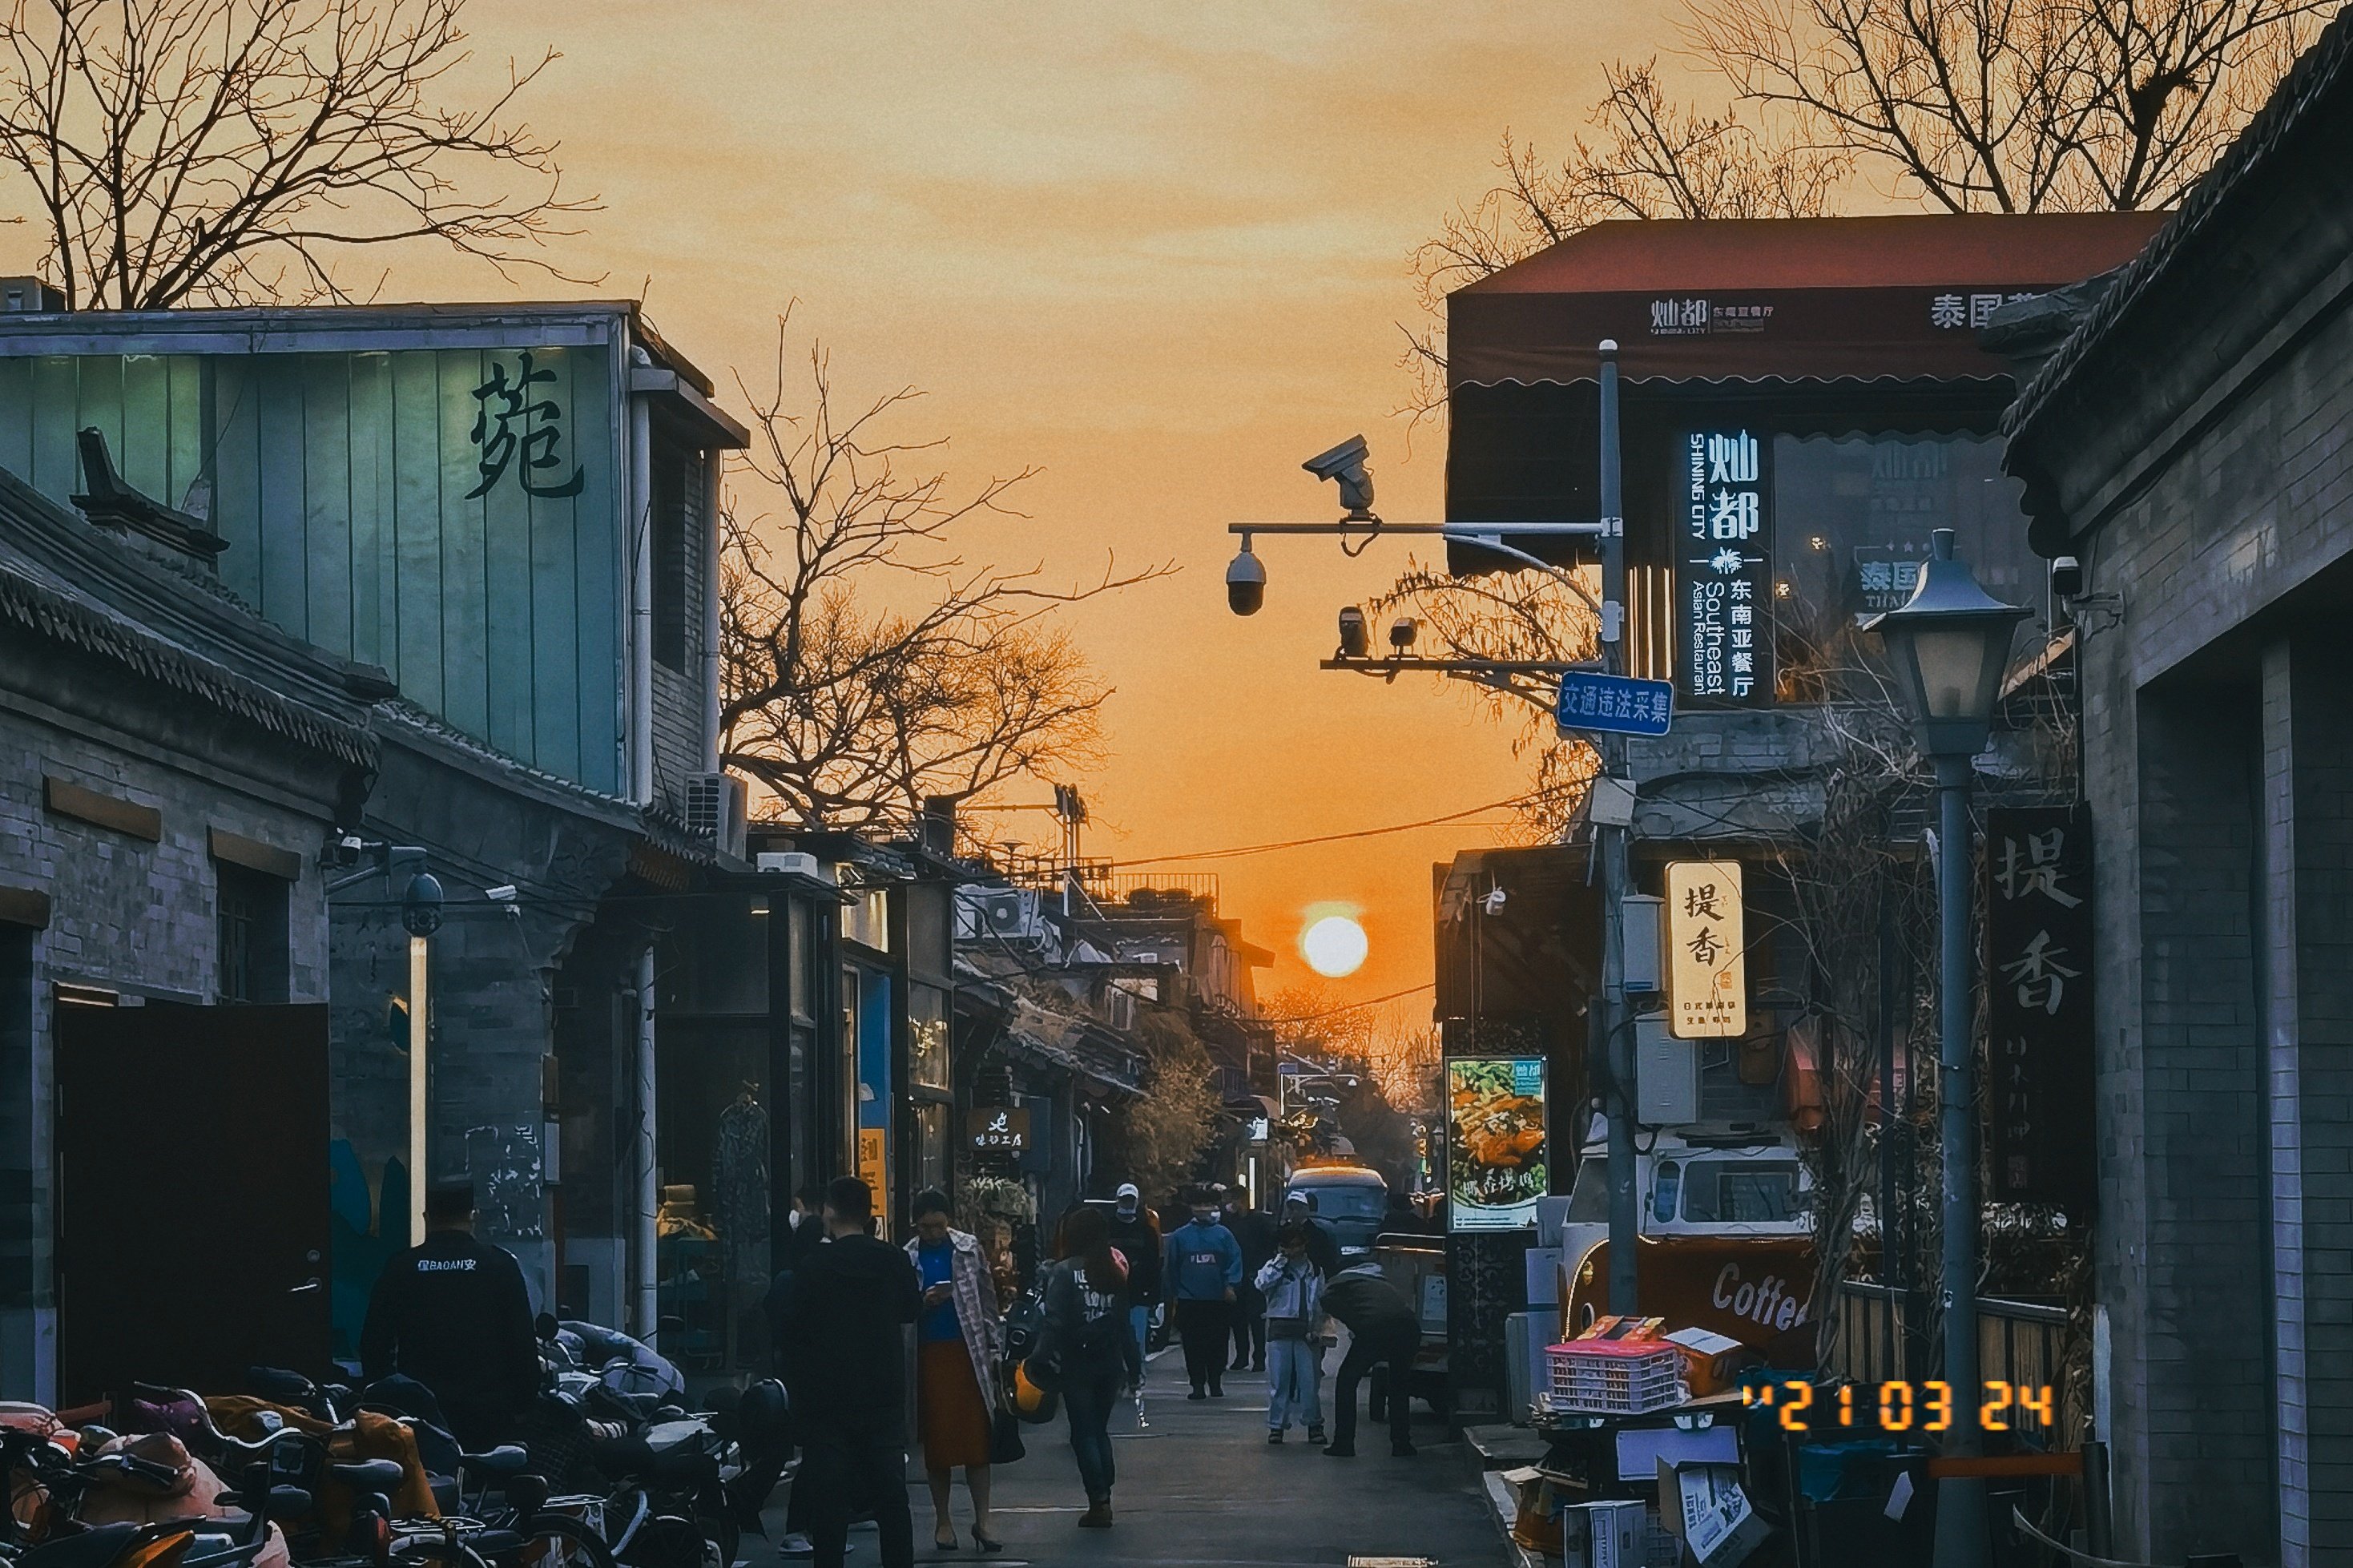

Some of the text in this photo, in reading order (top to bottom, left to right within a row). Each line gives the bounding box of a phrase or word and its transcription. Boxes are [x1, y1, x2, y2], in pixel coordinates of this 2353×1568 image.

[1650, 298, 1707, 328] 灿都
[1932, 292, 2047, 329] 泰国
[1690, 433, 1706, 540] SHINING CITY
[1707, 428, 1759, 540] 灿都
[1692, 580, 1706, 696] Asian Restaurant
[1705, 581, 1726, 695] Southeast
[1731, 578, 1755, 697] 东南亚餐厅
[1561, 683, 1669, 724] 交通违法采集
[1684, 883, 1725, 967] 提香
[1993, 827, 2083, 1017] 提香
